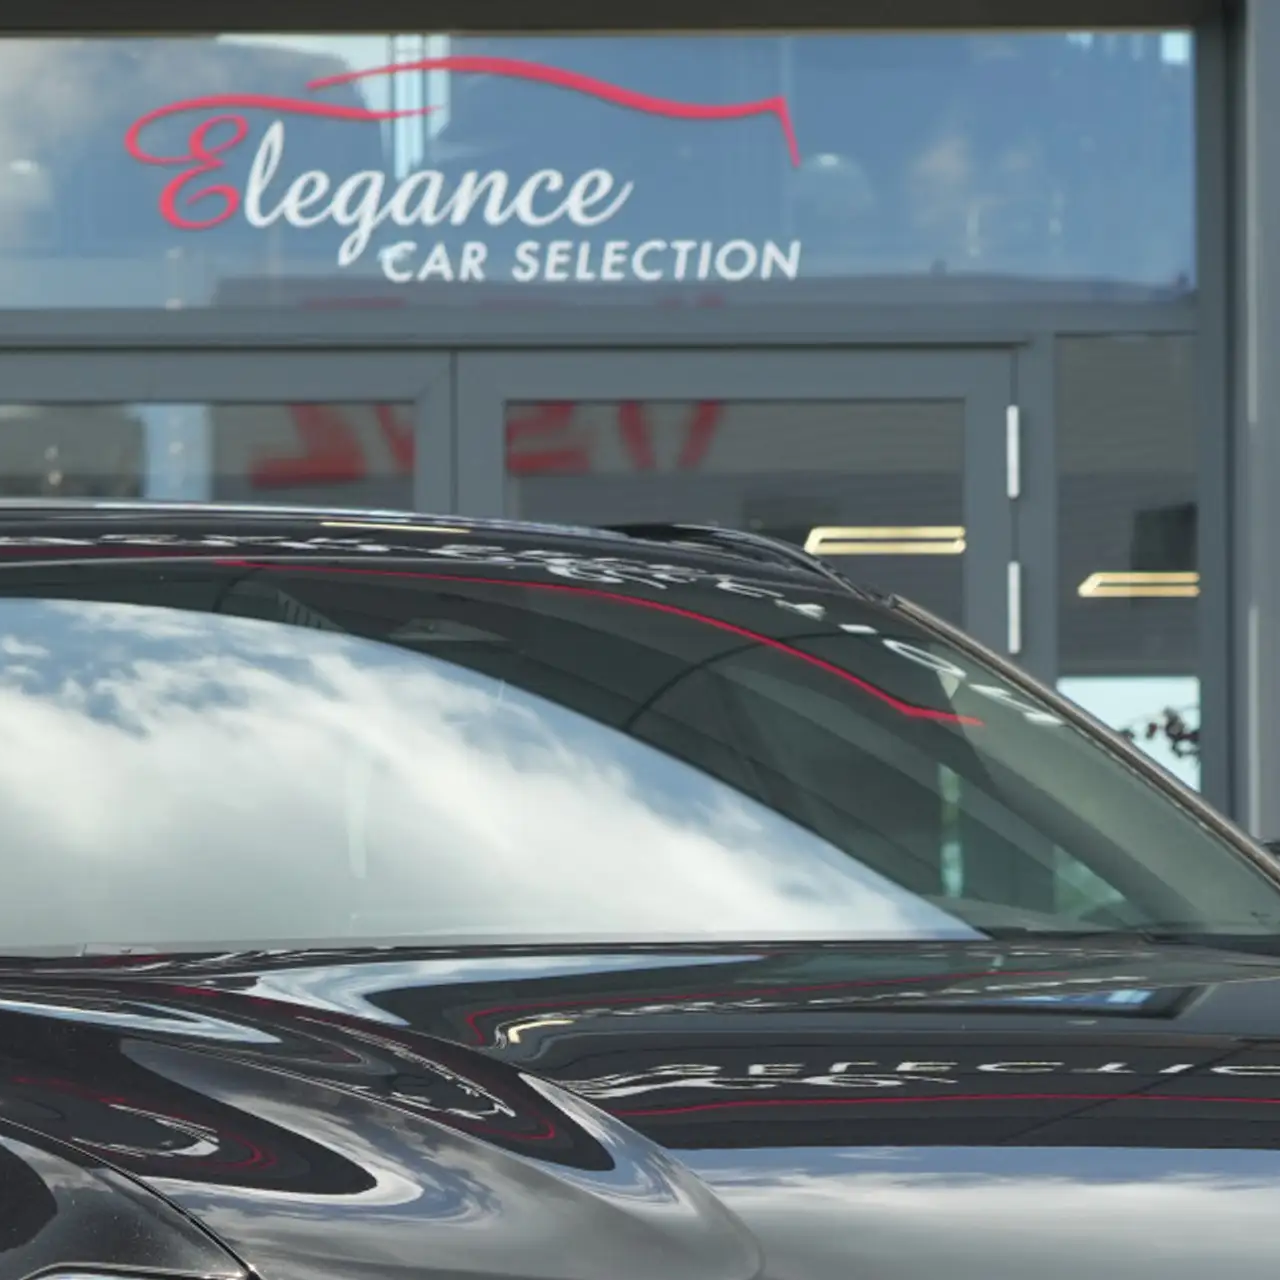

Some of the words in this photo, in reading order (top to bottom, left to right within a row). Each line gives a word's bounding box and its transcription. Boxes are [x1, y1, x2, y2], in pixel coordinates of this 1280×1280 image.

[125, 95, 633, 266] Elegance
[381, 240, 487, 283] CAR
[511, 240, 801, 282] SELECTION
